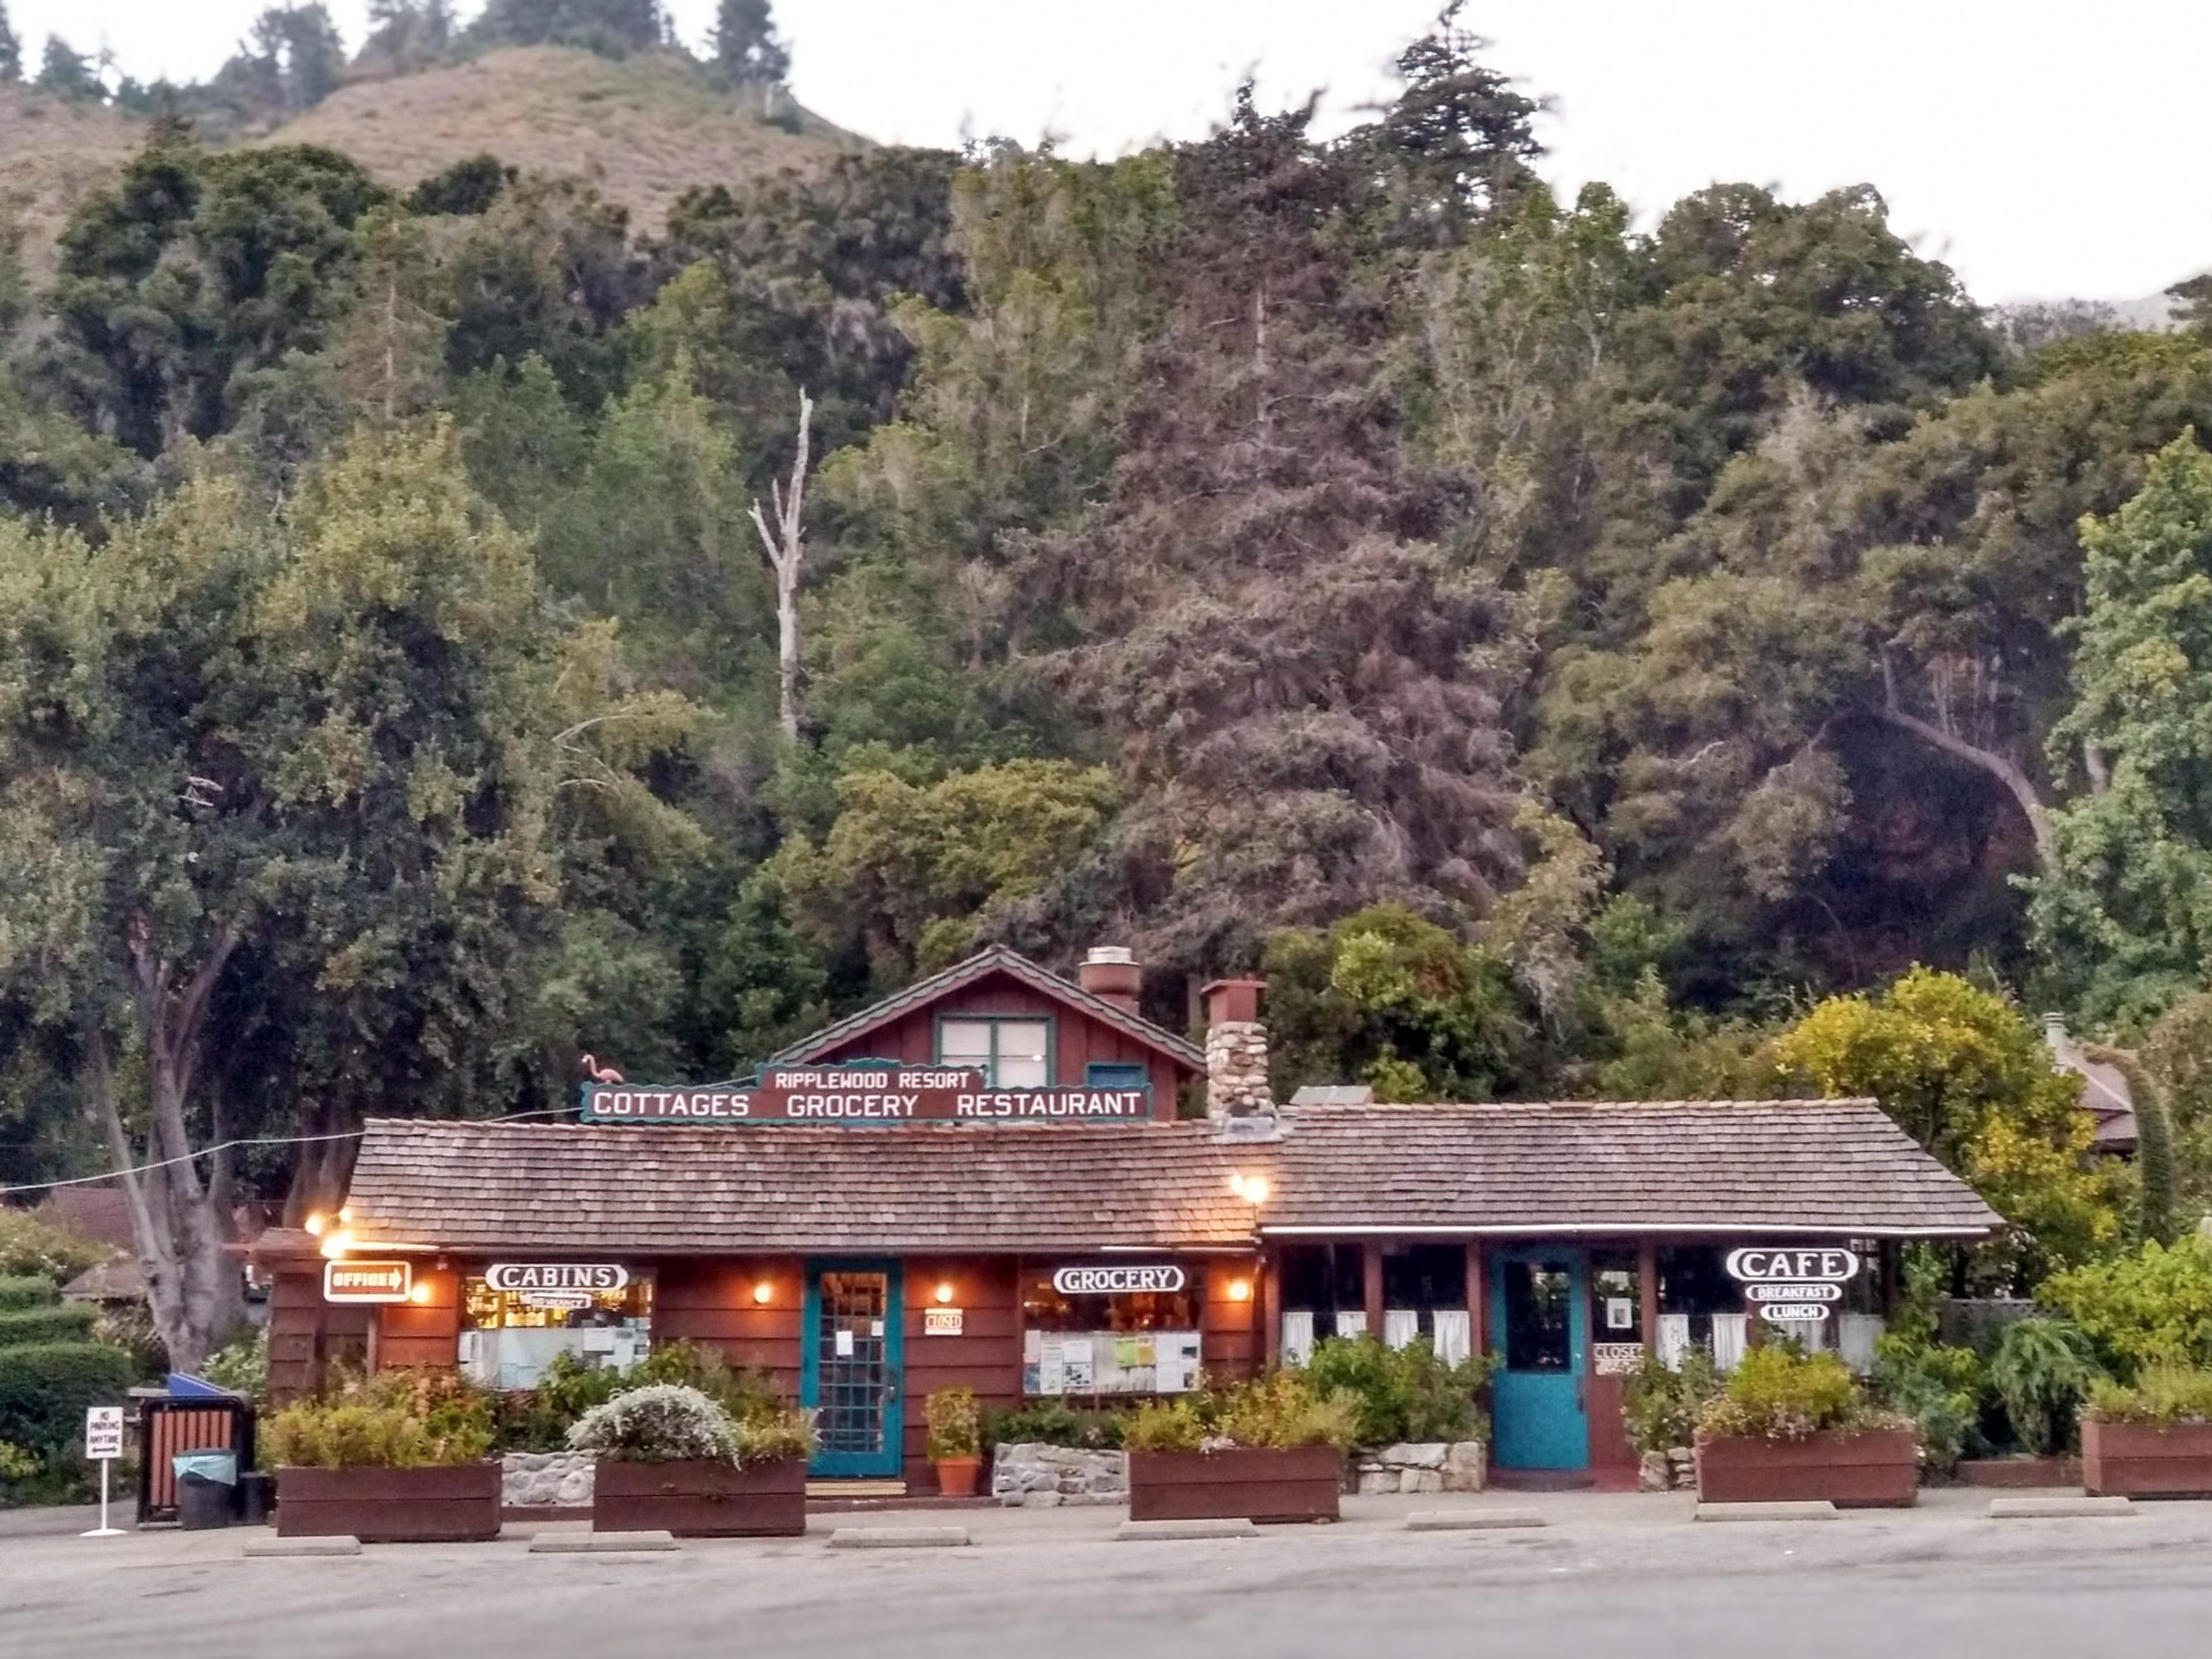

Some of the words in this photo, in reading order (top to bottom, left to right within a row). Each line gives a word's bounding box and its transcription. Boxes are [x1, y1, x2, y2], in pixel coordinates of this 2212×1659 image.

[775, 1072, 888, 1089] RIPPLEWOOD
[899, 1072, 969, 1088] RESORT
[593, 1092, 749, 1116] COTTAGES
[786, 1094, 919, 1117] GROCERY
[957, 1092, 1141, 1116] RESTAURANT
[1741, 1252, 1844, 1277] CAFE
[502, 1267, 612, 1287] CABINS
[1065, 1270, 1171, 1290] GROCERY
[1758, 1287, 1830, 1298] BREAKFAST
[1772, 1306, 1819, 1318] LUNCH
[925, 1315, 963, 1328] CLOSED
[90, 1421, 120, 1430] PARKING
